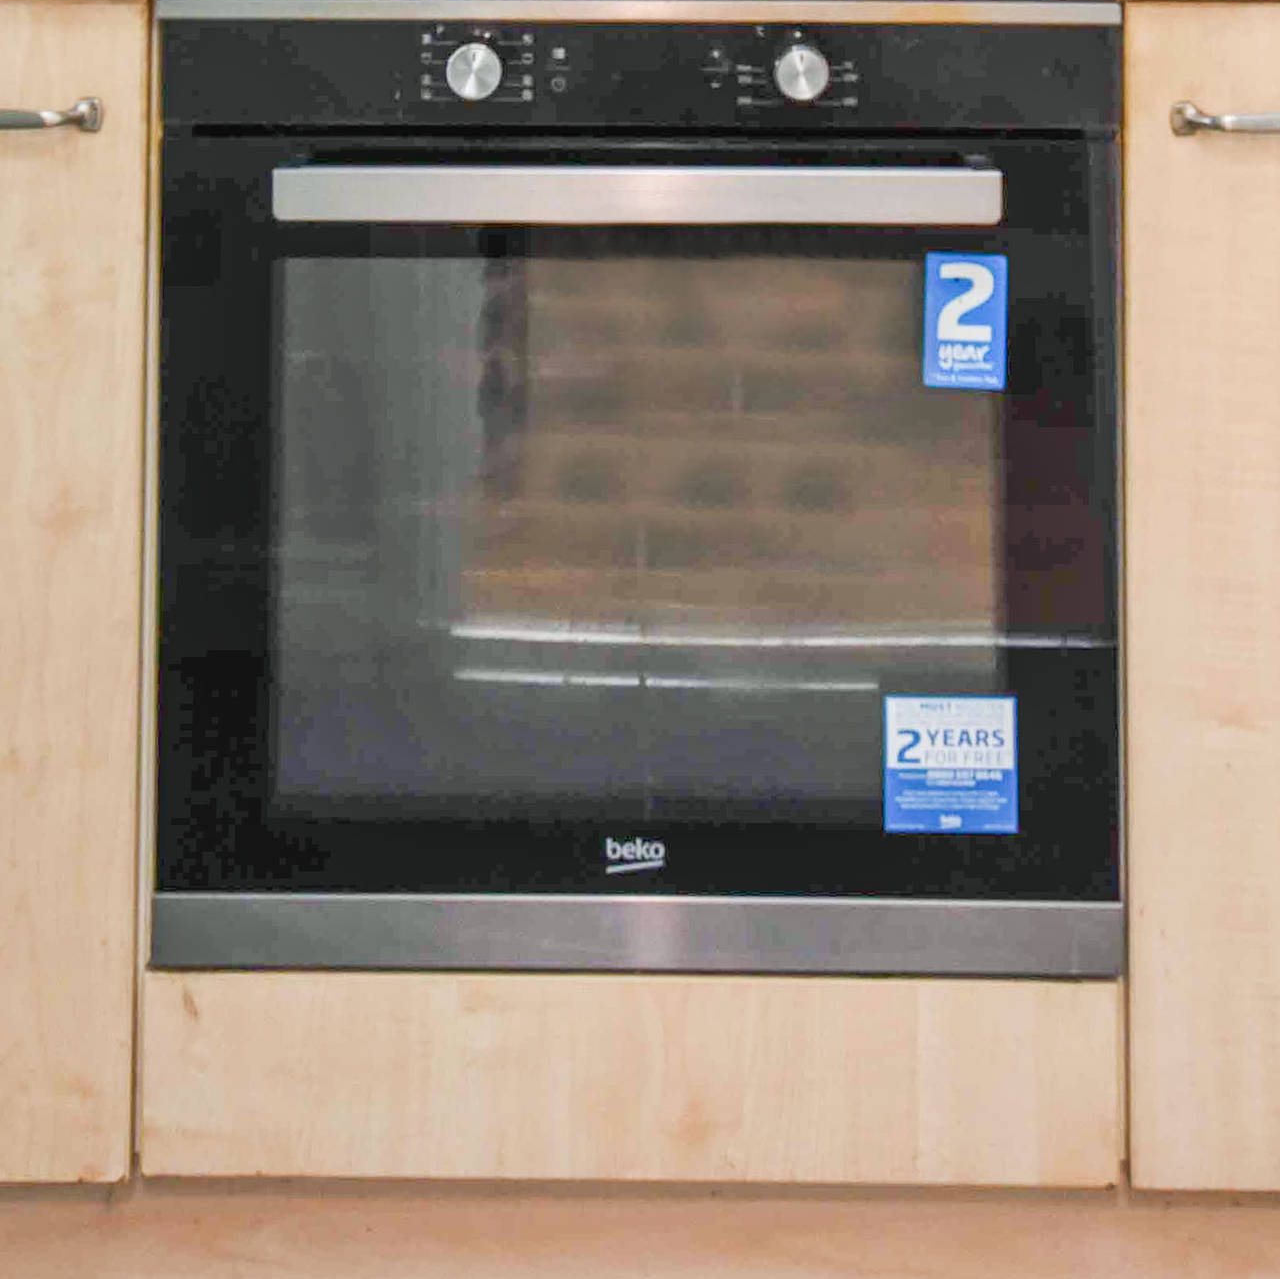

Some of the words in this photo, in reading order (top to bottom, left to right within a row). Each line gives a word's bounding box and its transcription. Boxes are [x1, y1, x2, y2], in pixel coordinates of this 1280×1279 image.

[937, 262, 995, 342] 2
[897, 729, 921, 763] 2
[926, 729, 1006, 747] YEARS
[605, 836, 666, 861] beko
